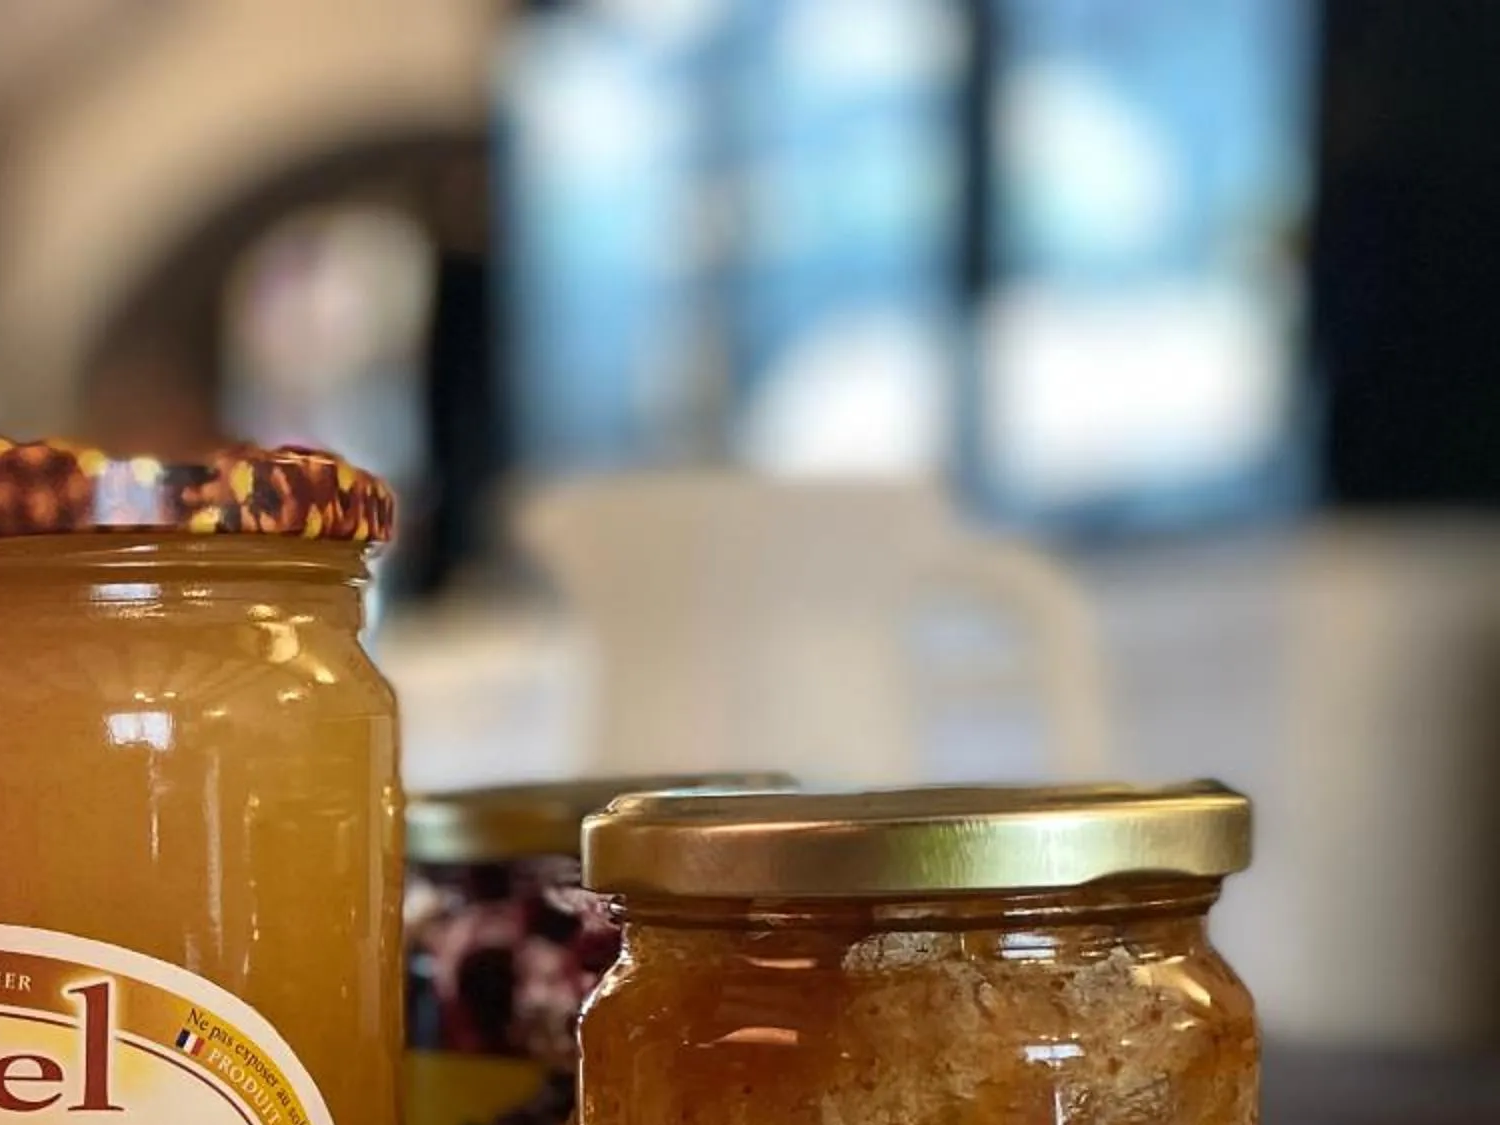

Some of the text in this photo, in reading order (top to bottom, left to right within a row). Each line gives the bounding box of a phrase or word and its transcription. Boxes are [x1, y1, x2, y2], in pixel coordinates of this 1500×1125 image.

[187, 1008, 209, 1031] Ne
[208, 1023, 234, 1048] pas
[235, 1042, 278, 1087] exposer
[276, 1087, 290, 1106] au
